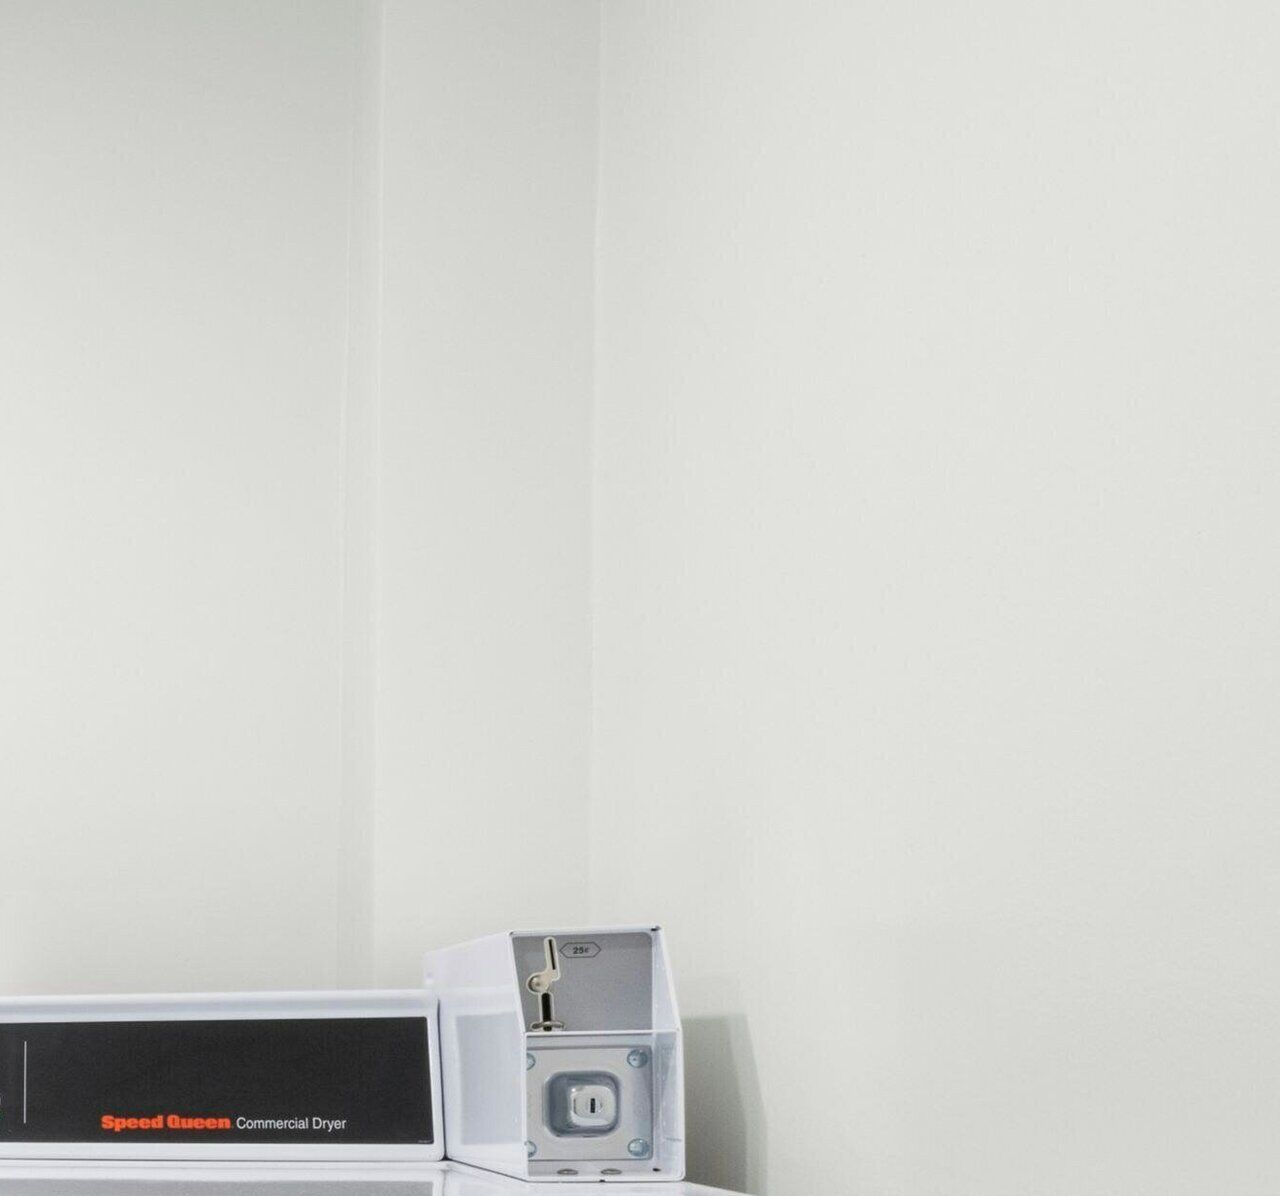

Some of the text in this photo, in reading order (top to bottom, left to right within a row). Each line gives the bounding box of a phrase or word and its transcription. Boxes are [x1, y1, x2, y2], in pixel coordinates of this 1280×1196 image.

[101, 1114, 347, 1132] Speed Queen Commercial Dryer
